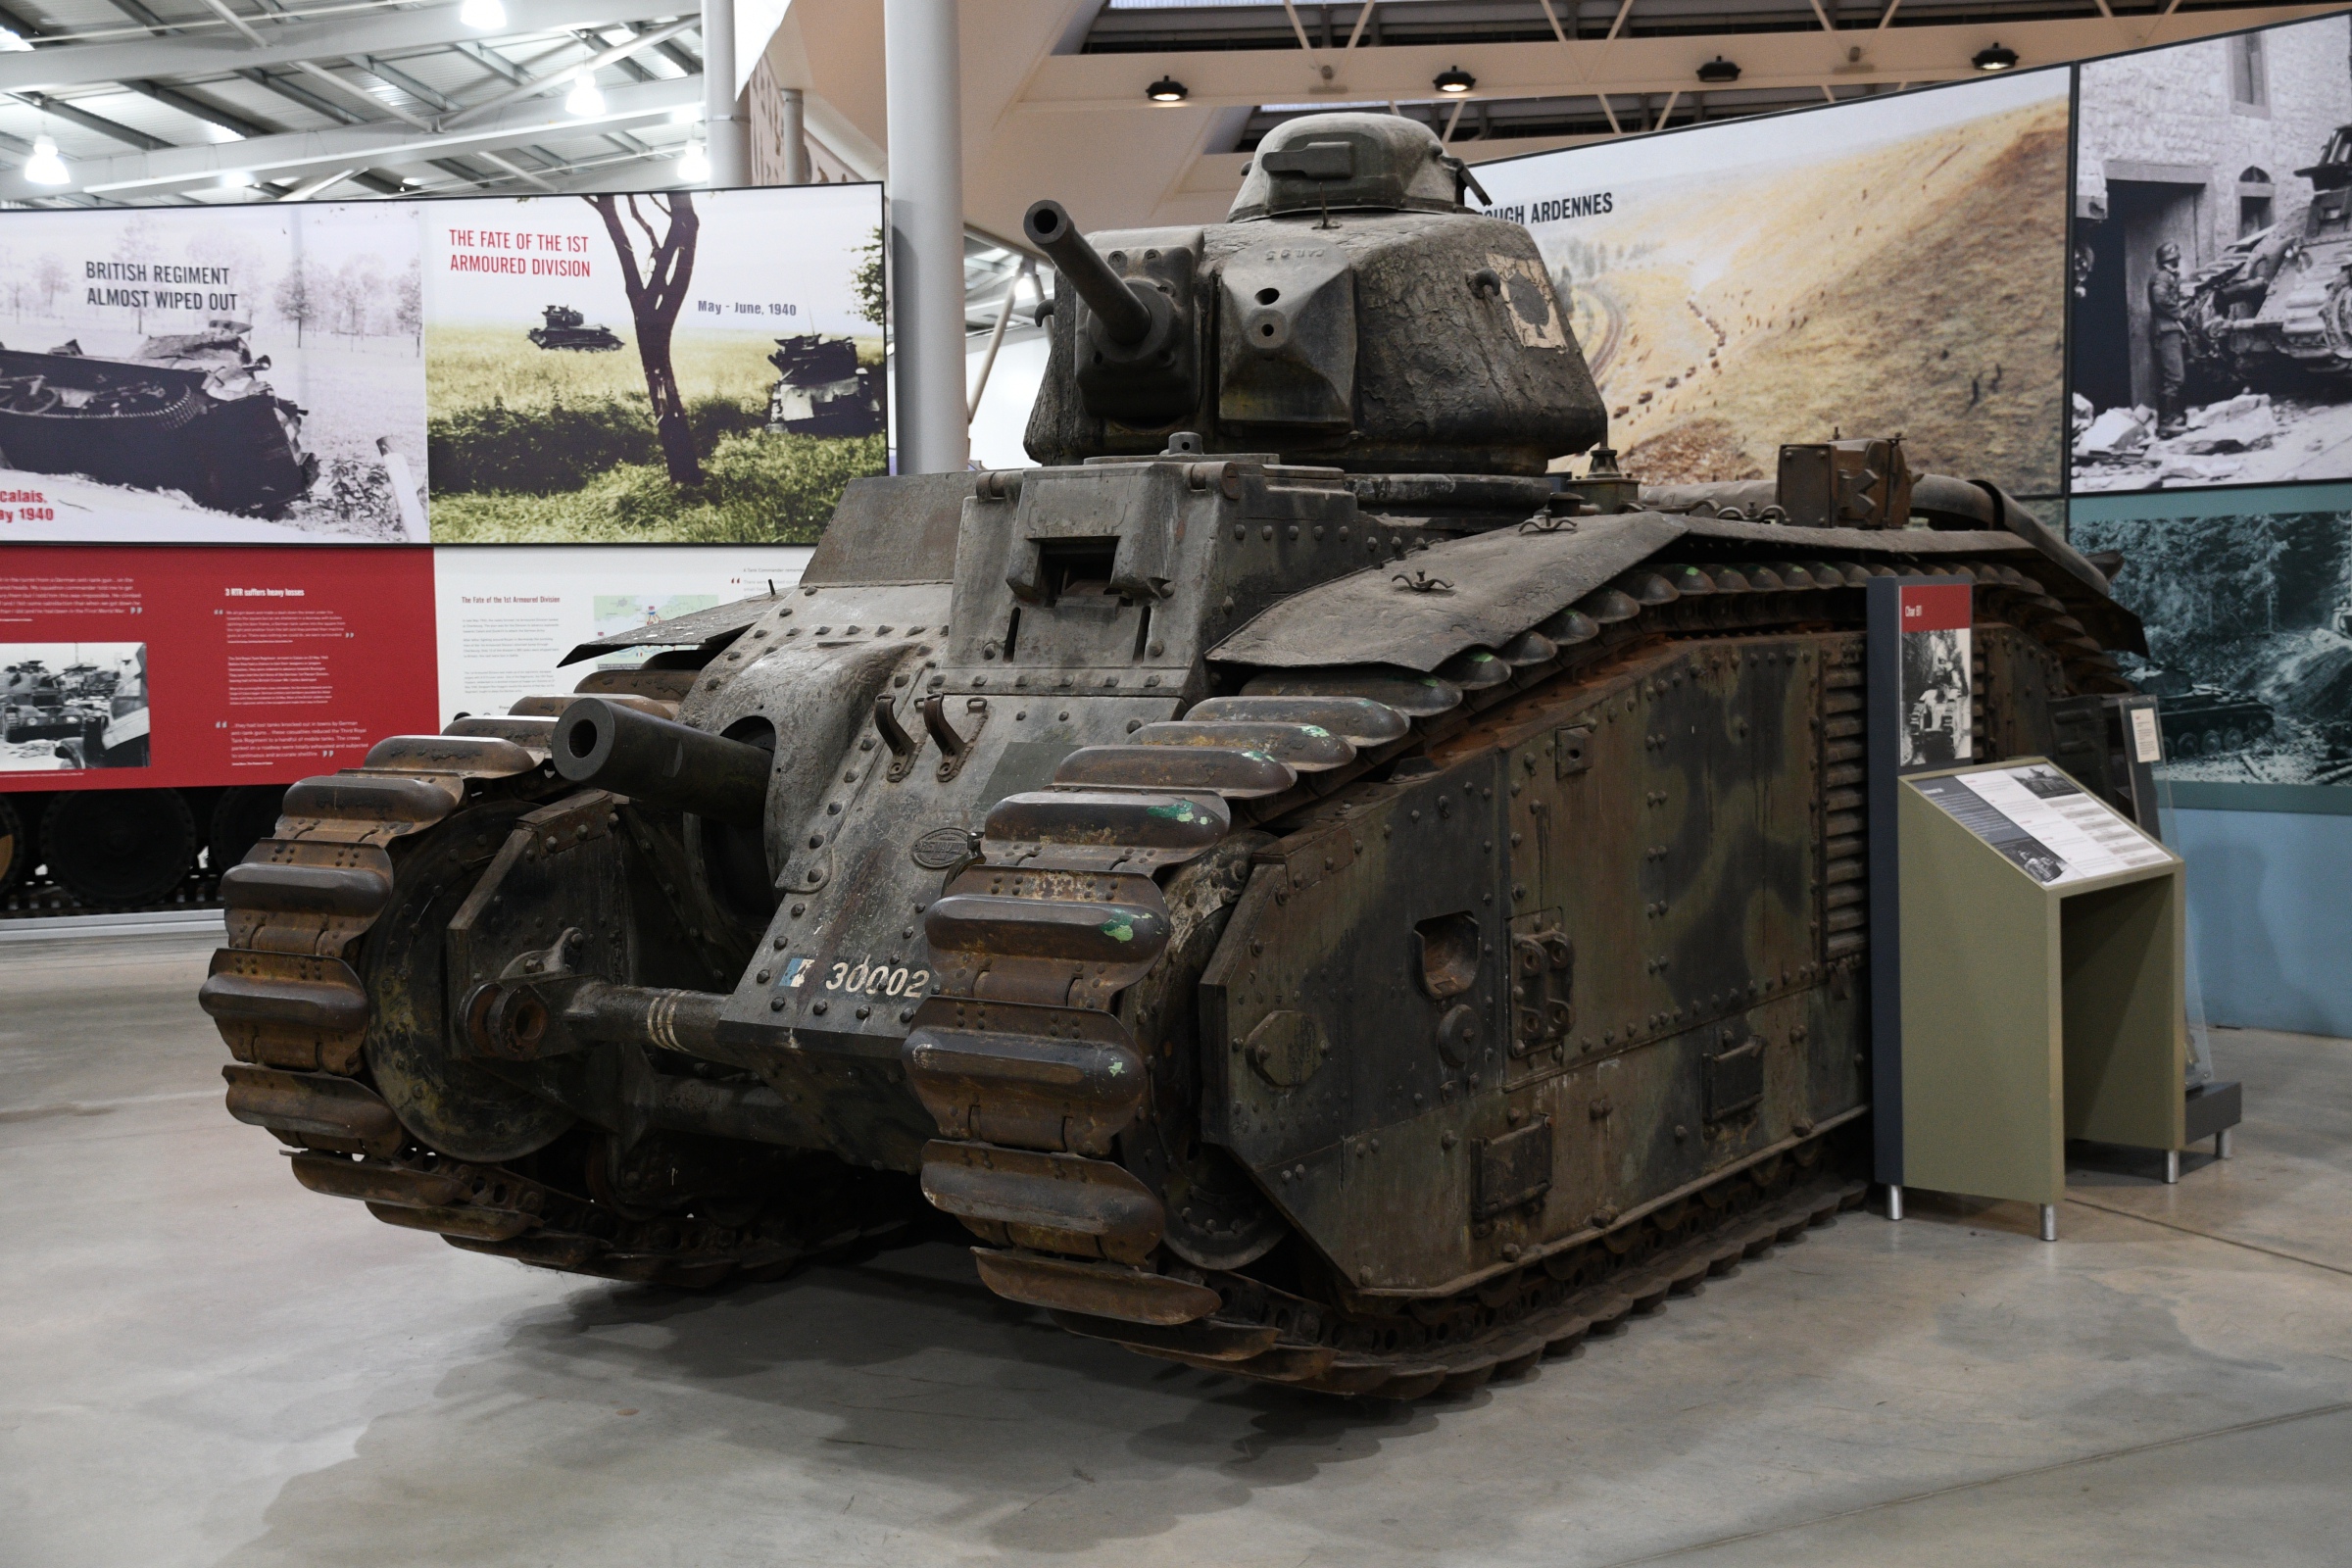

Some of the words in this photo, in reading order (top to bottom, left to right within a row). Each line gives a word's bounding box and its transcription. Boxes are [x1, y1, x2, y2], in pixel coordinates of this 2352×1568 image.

[1531, 192, 1613, 223] ARDENNES
[449, 229, 474, 247] THE
[480, 231, 511, 249] FATE
[516, 233, 532, 250] OF
[537, 234, 562, 251] THE
[566, 235, 589, 253] 1ST
[86, 261, 147, 282] BRITISH
[153, 265, 230, 285] REGIMENT
[451, 255, 526, 274] ARMOURED
[532, 258, 590, 277] DIVISION
[87, 287, 150, 309] ALMOST
[154, 291, 203, 310] WIPED
[209, 293, 238, 311] OUT
[698, 300, 721, 315] May
[734, 302, 764, 316] June,
[768, 303, 797, 317] 1940
[19, 508, 54, 520] 1940
[267, 588, 284, 597] heavy
[825, 961, 930, 998] 30002
